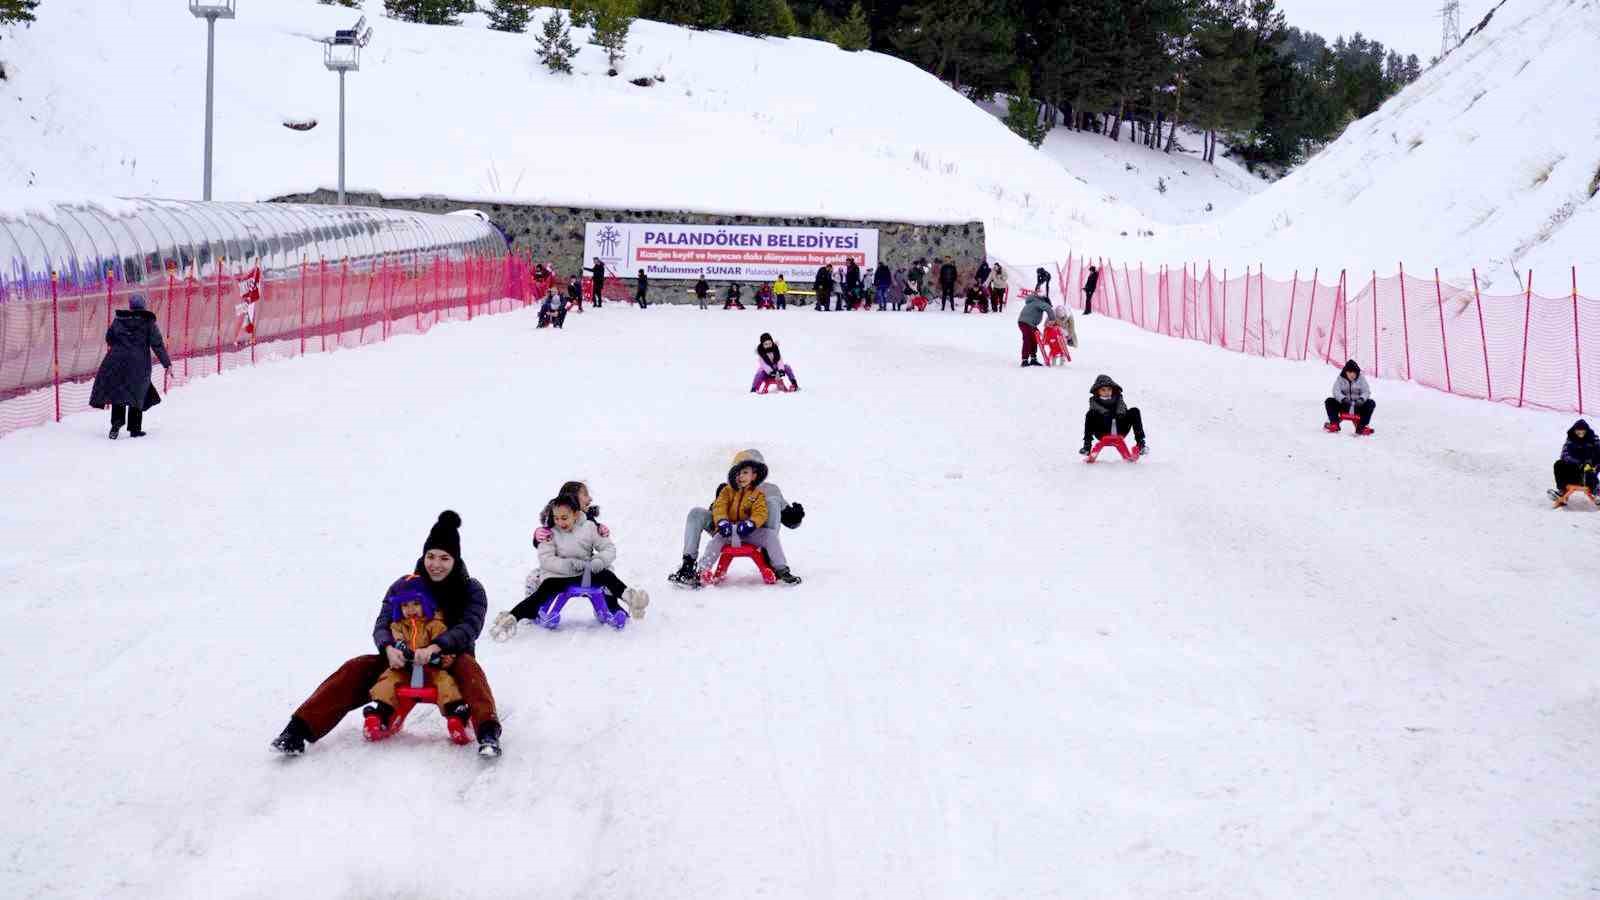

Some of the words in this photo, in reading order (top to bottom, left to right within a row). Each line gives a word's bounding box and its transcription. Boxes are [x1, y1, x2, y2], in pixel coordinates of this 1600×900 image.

[645, 230, 761, 246] PALANDÖKEN
[768, 232, 858, 248] BELEDİYESİ
[672, 250, 694, 262] keyif
[695, 252, 706, 260] ve
[707, 251, 741, 262] heyecan
[808, 253, 824, 264] hoş
[648, 265, 704, 274] Muhammet
[706, 266, 741, 275] SUNAR
